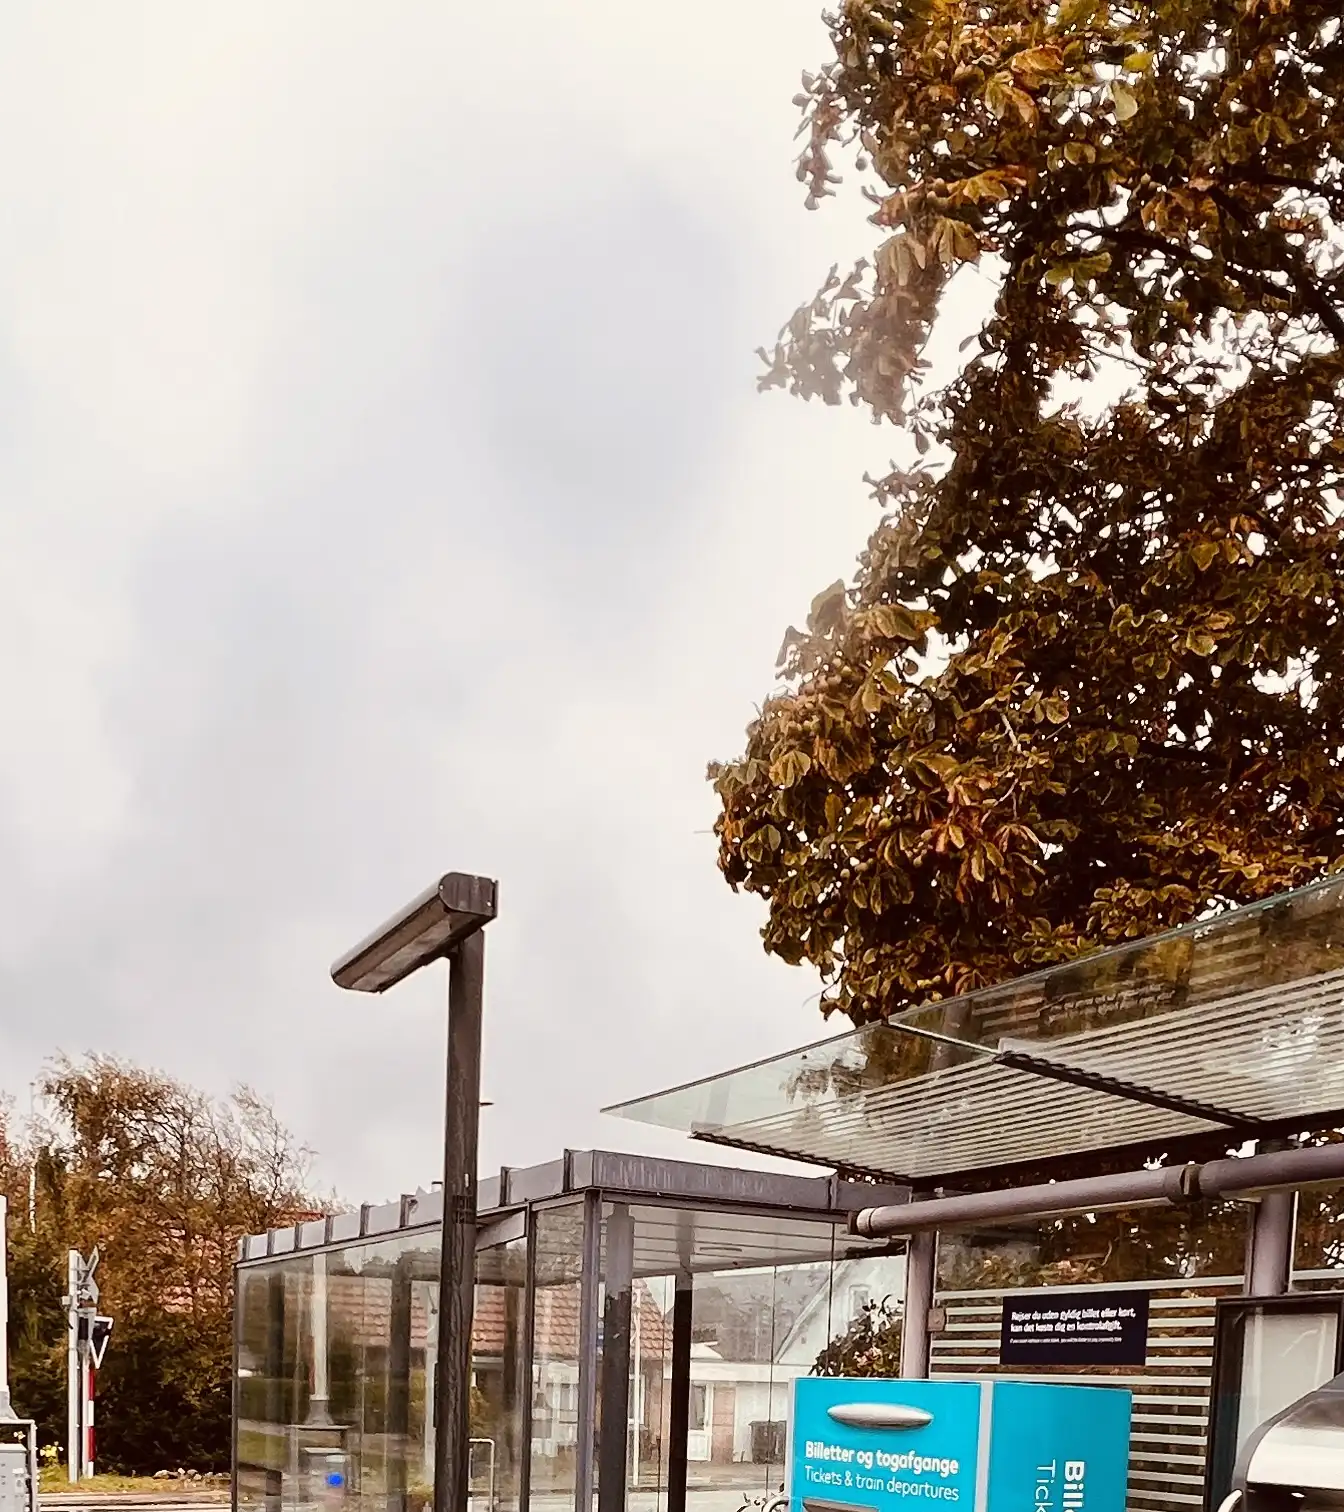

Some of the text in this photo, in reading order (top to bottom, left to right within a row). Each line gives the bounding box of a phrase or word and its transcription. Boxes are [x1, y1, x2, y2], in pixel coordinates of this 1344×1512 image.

[1032, 1311, 1041, 1320] du
[1082, 1307, 1099, 1318] billet
[1010, 1322, 1022, 1332] kan
[1054, 1321, 1065, 1332] dig
[805, 1440, 959, 1478] Billetter og togafgange
[805, 1465, 959, 1501] Tickets & train departures
